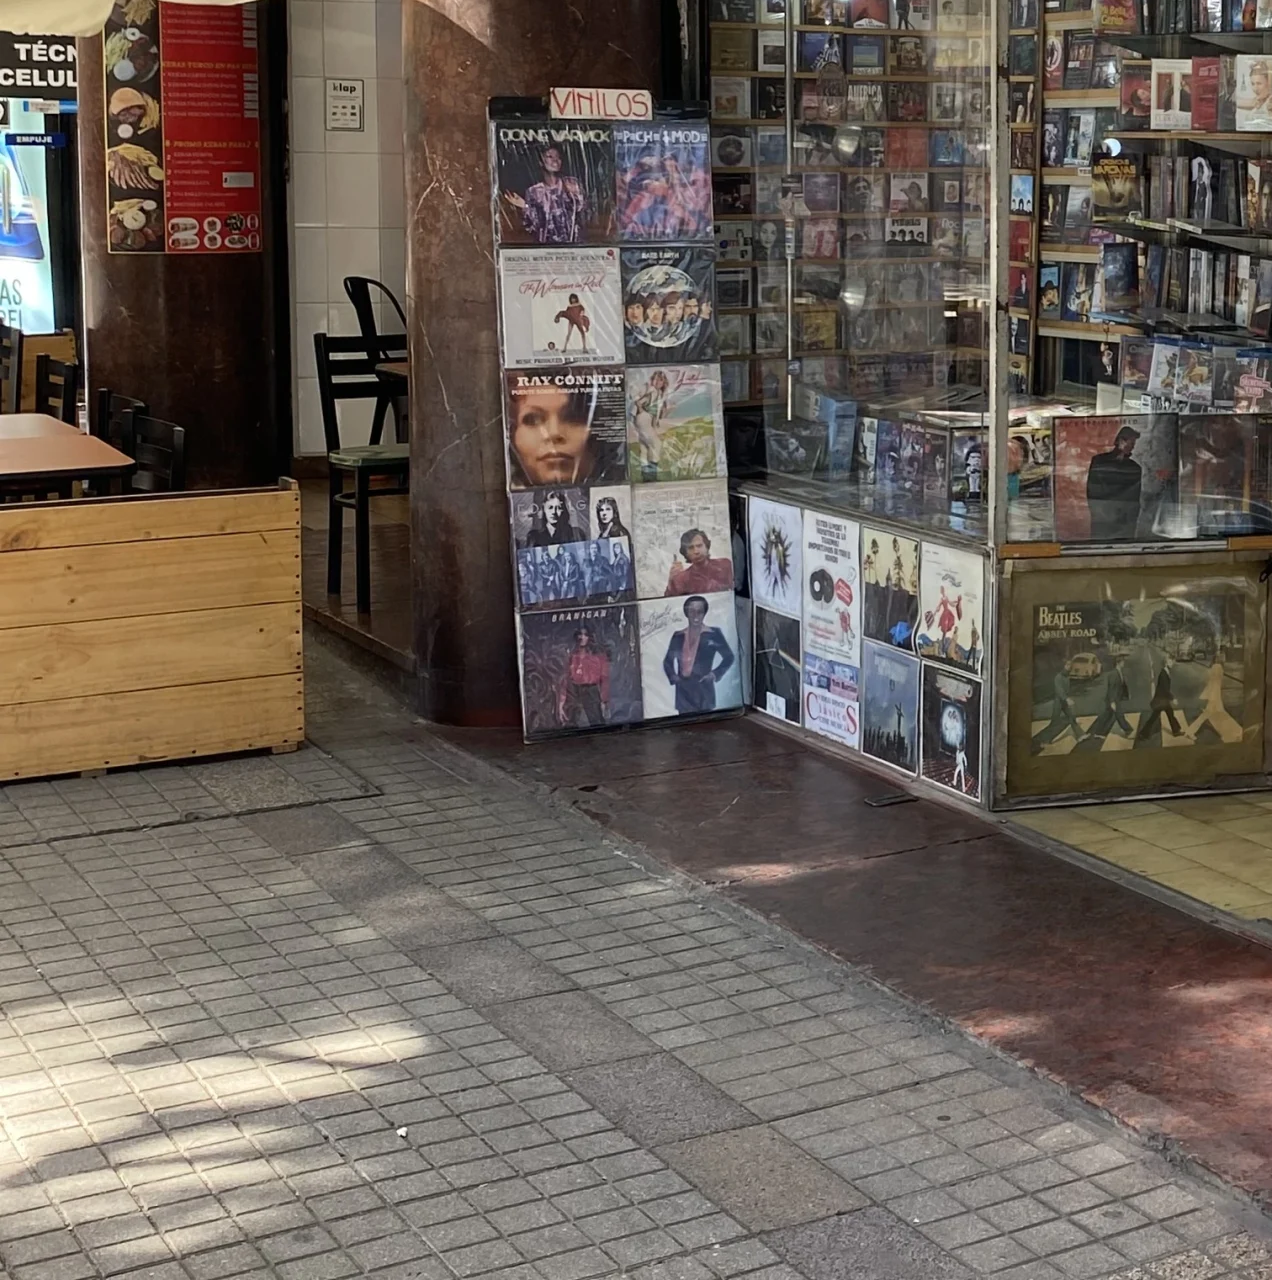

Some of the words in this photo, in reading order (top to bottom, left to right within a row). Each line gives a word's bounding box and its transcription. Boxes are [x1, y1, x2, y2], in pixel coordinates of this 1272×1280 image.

[332, 82, 357, 94] klap
[551, 89, 649, 118] VINILOS
[516, 375, 552, 387] RAY
[554, 373, 624, 387] CONNIFF
[551, 609, 607, 622] BRANIGAN
[1039, 606, 1082, 629] BEATLES
[1038, 629, 1067, 639] ABBEY
[1070, 628, 1097, 637] ROAD
